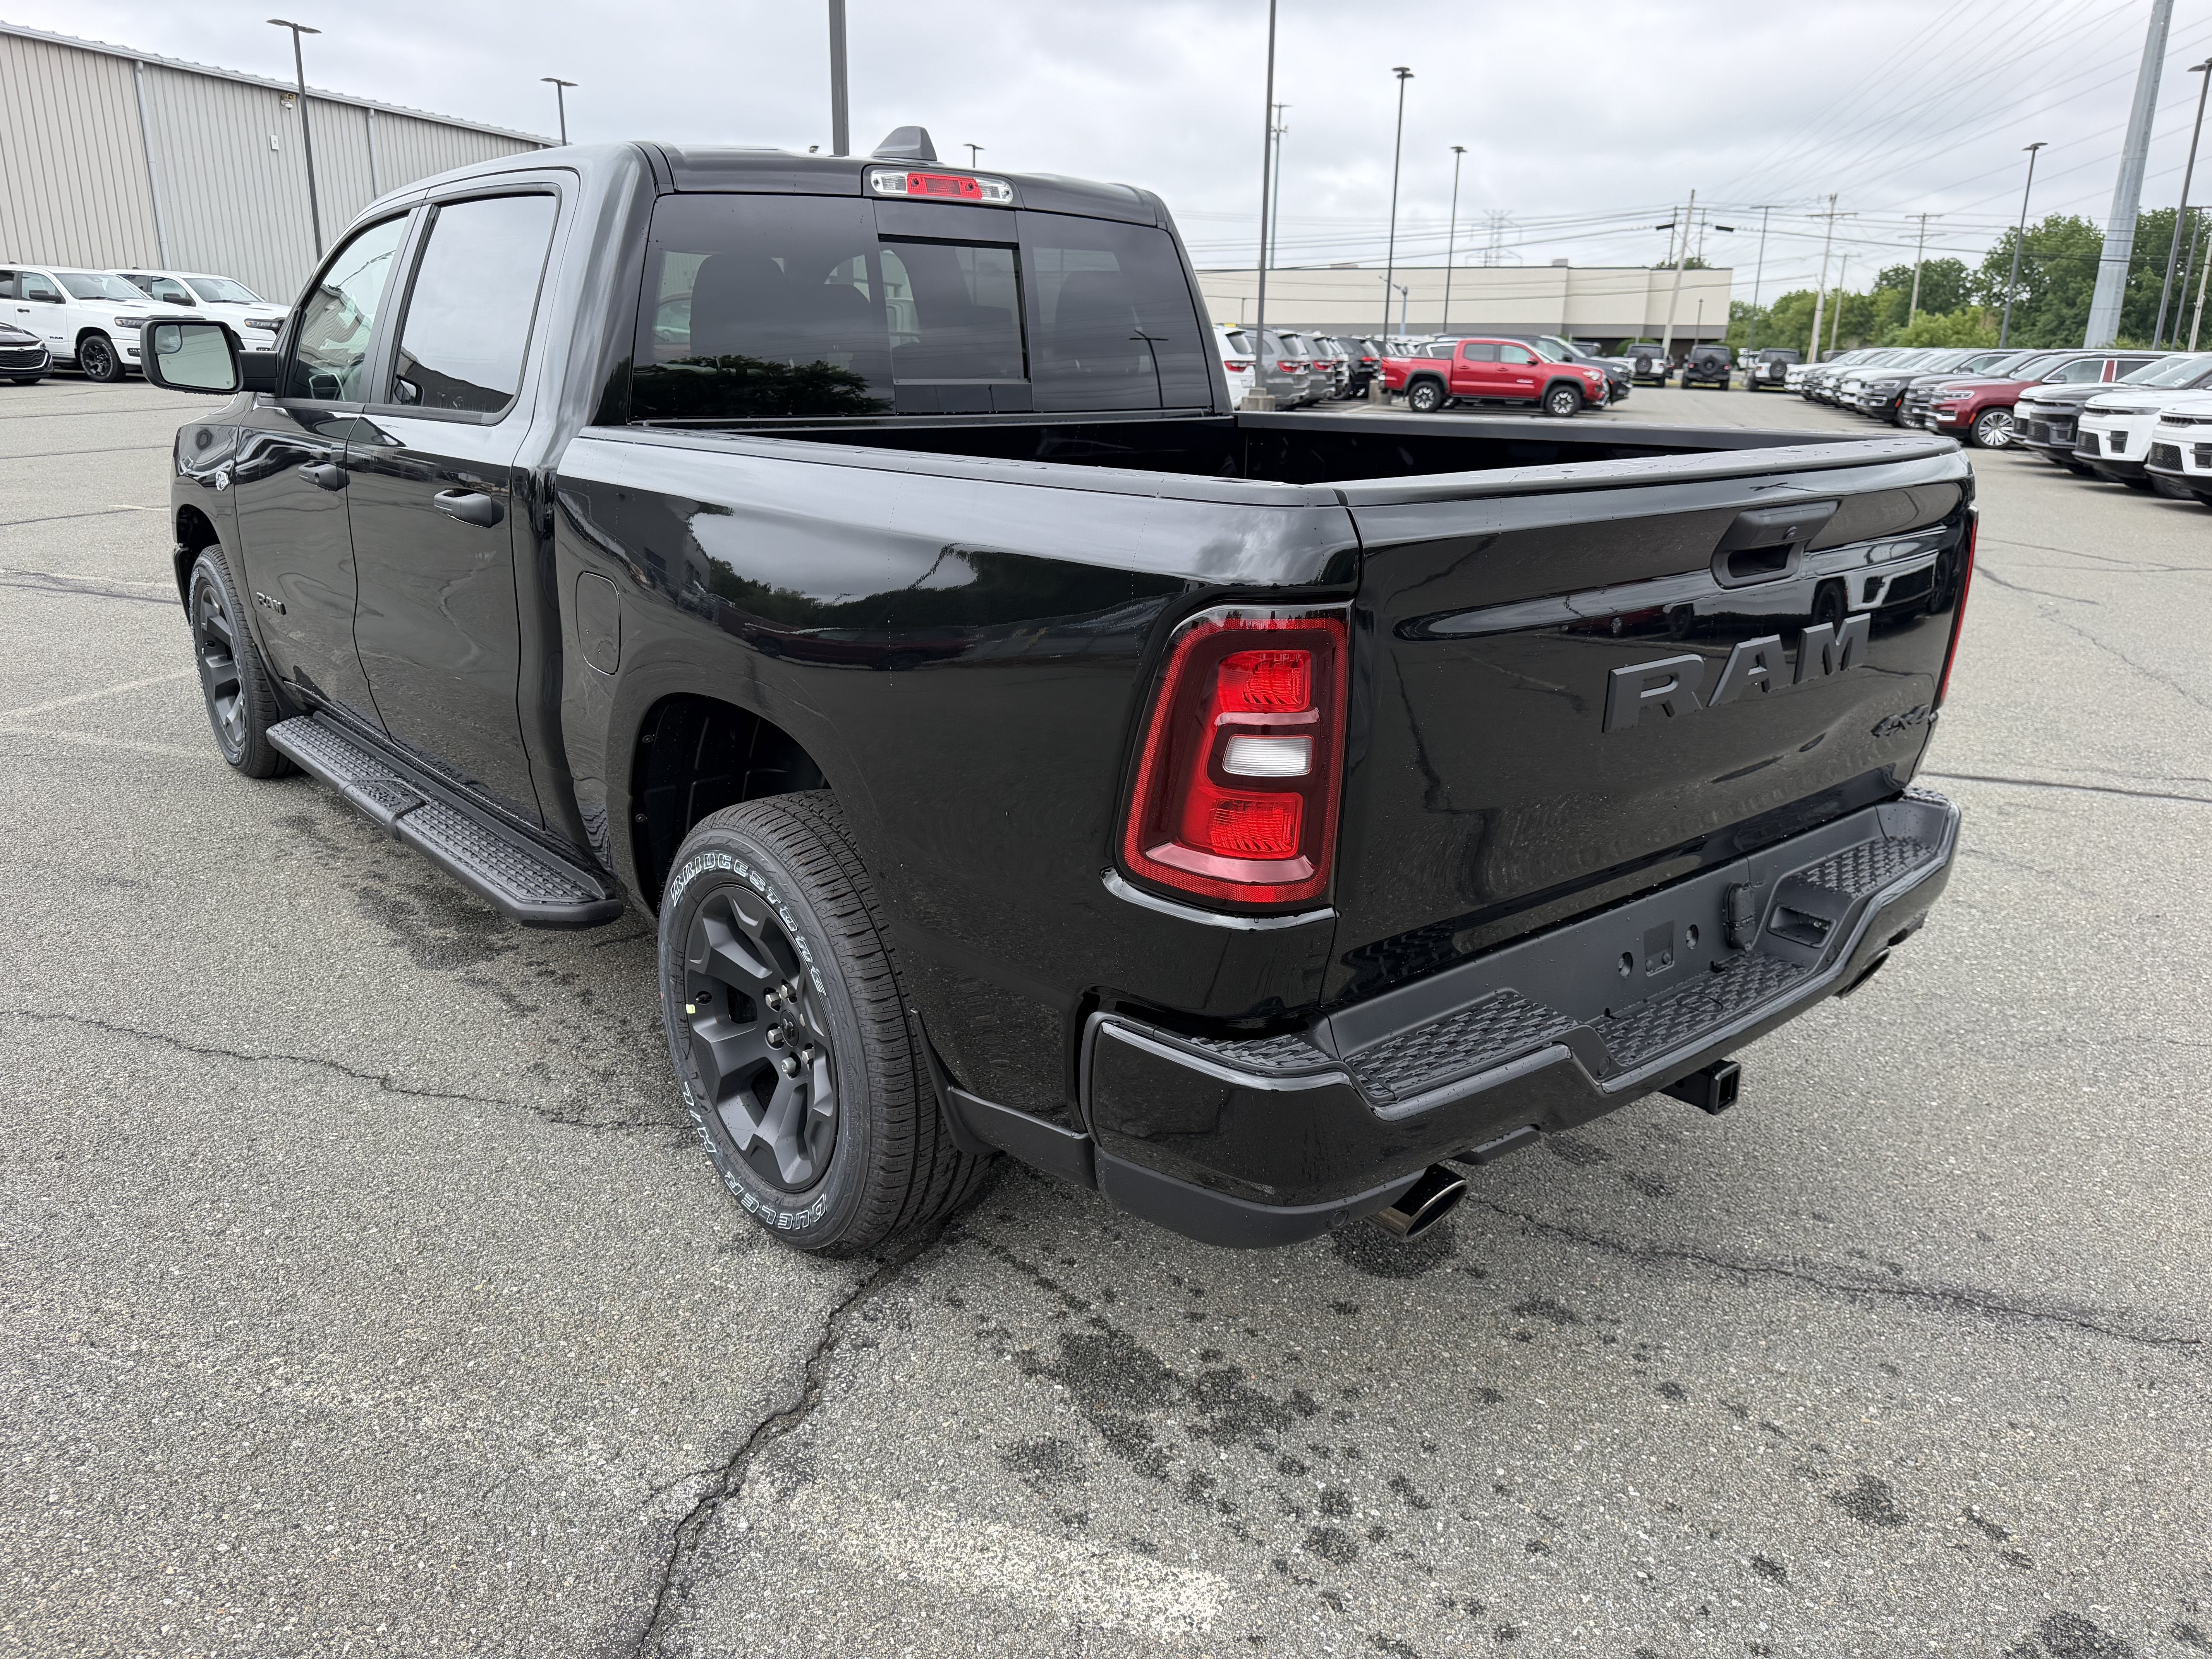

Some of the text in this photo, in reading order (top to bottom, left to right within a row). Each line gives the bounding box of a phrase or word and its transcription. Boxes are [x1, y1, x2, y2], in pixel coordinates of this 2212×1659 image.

[256, 592, 286, 616] RAM
[1602, 612, 1871, 733] RAM
[670, 853, 827, 996] BRIDGESTONE
[724, 1171, 827, 1230] DUELER
